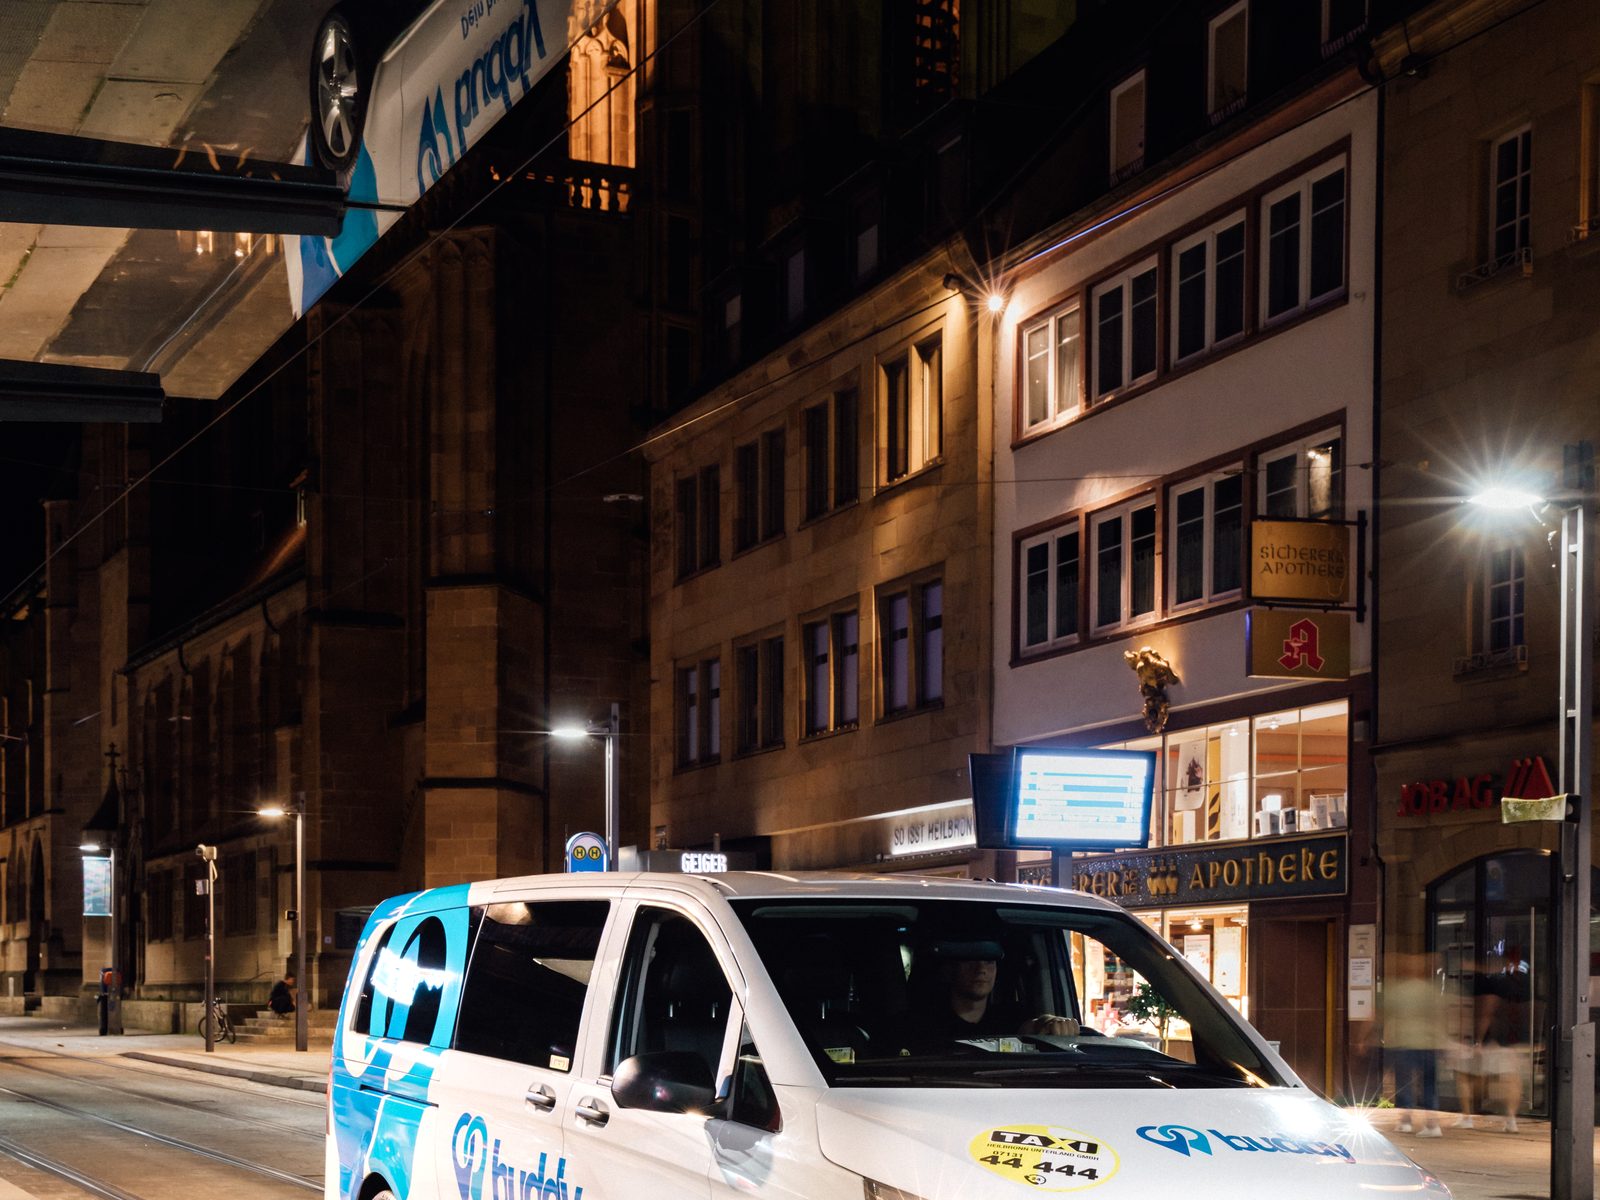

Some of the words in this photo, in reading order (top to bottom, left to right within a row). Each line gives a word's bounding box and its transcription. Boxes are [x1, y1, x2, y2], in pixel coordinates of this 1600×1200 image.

[1278, 617, 1325, 673] A
[1397, 780, 1448, 817] JOB
[1453, 774, 1493, 811] AG
[894, 827, 904, 846] SO
[928, 817, 973, 841] HEILBRON
[681, 852, 728, 873] GEIGER
[1189, 847, 1339, 890] APOTHEKE
[986, 1143, 1029, 1152] HEILBRONN
[1030, 1148, 1076, 1158] UNTERLAND
[992, 1150, 1023, 1158] 07131
[999, 1131, 1089, 1153] TAXI
[1206, 1129, 1357, 1164] buddy
[979, 1155, 1023, 1169] 44
[1033, 1161, 1099, 1180] 444
